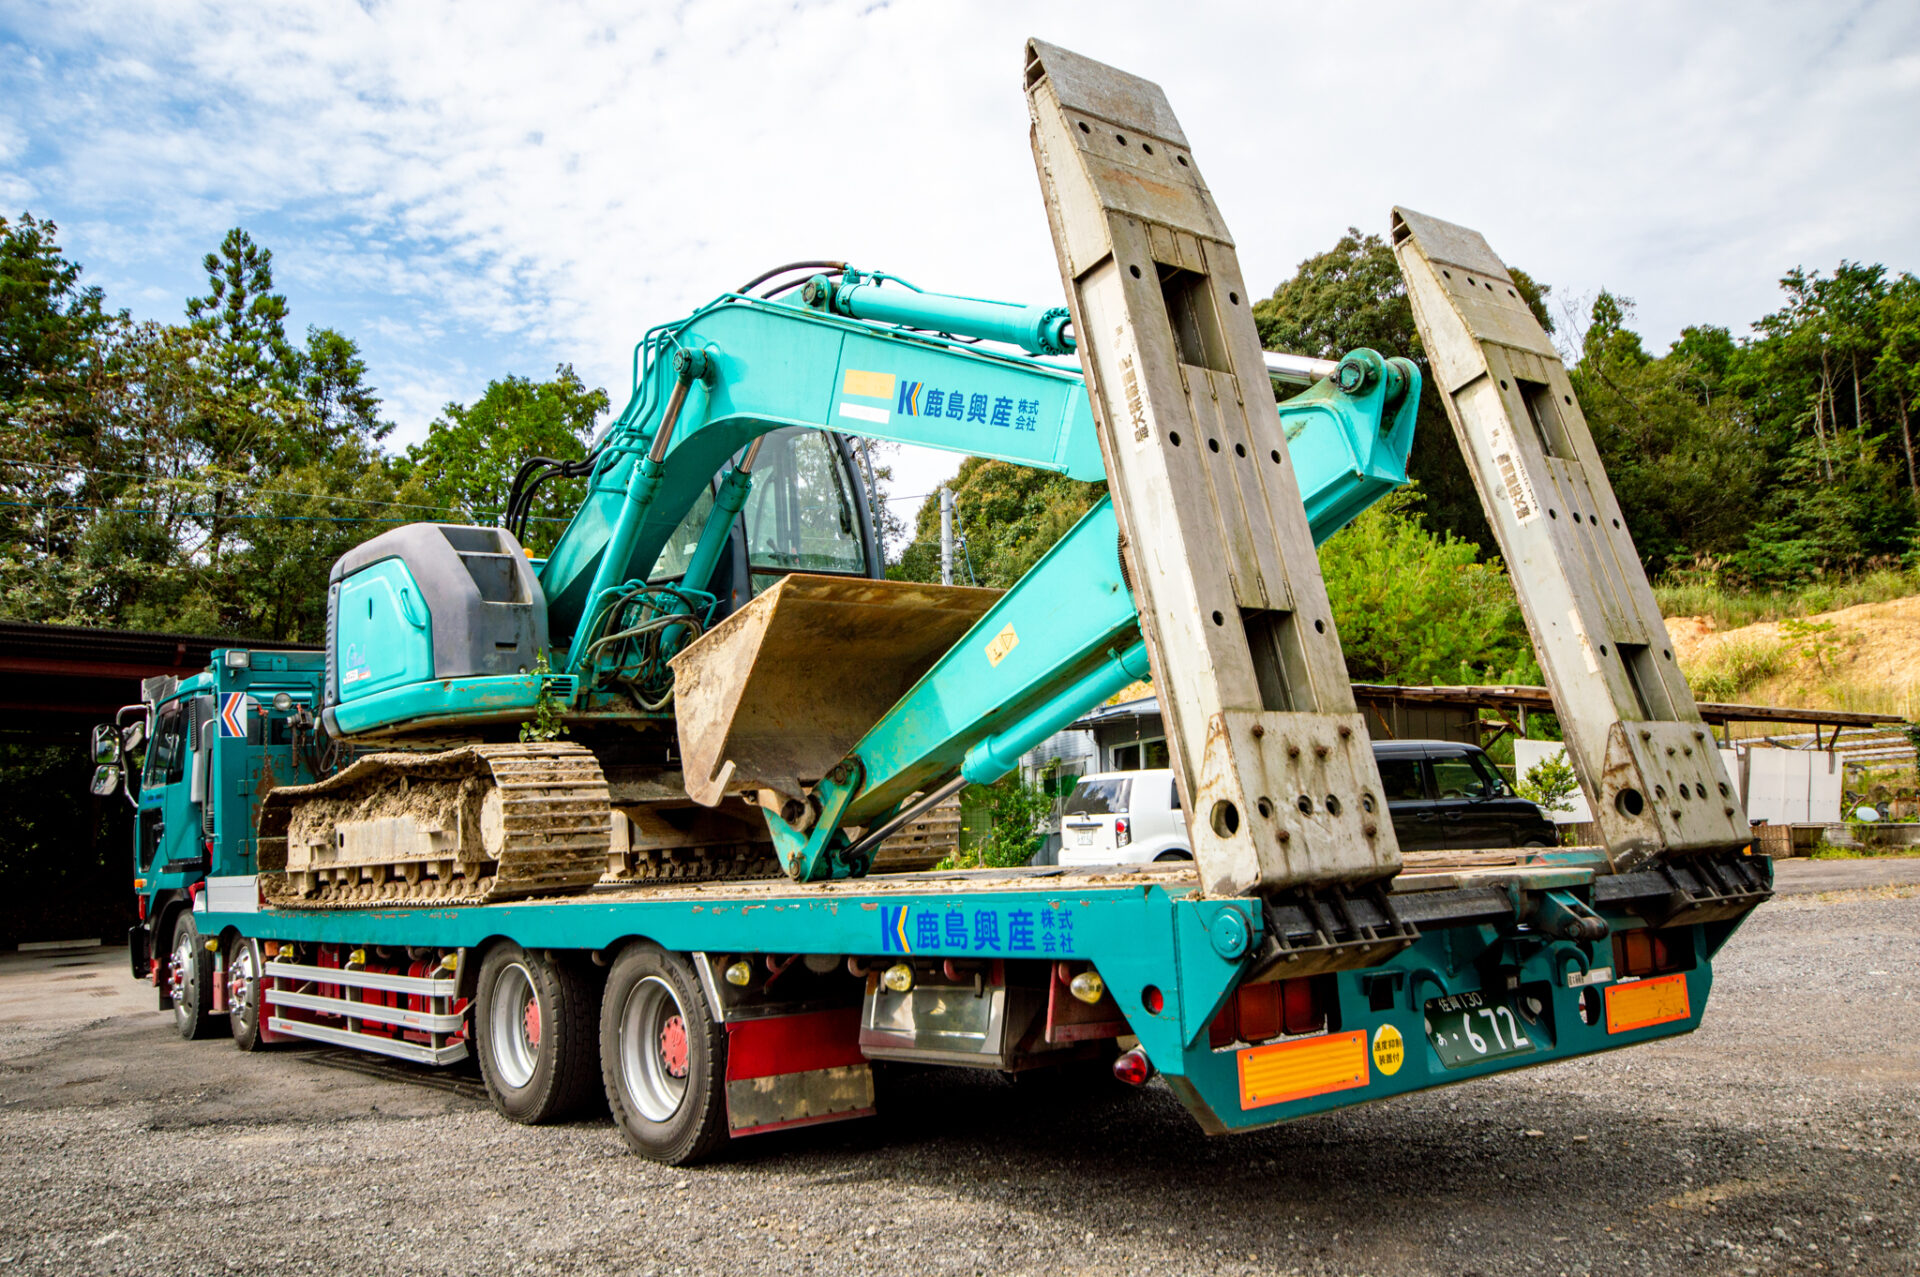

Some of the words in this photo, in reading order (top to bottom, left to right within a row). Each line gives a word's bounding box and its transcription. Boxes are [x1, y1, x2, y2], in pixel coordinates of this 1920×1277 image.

[923, 388, 1013, 427] 鹿島興産
[916, 908, 1036, 952] 鹿島興産
